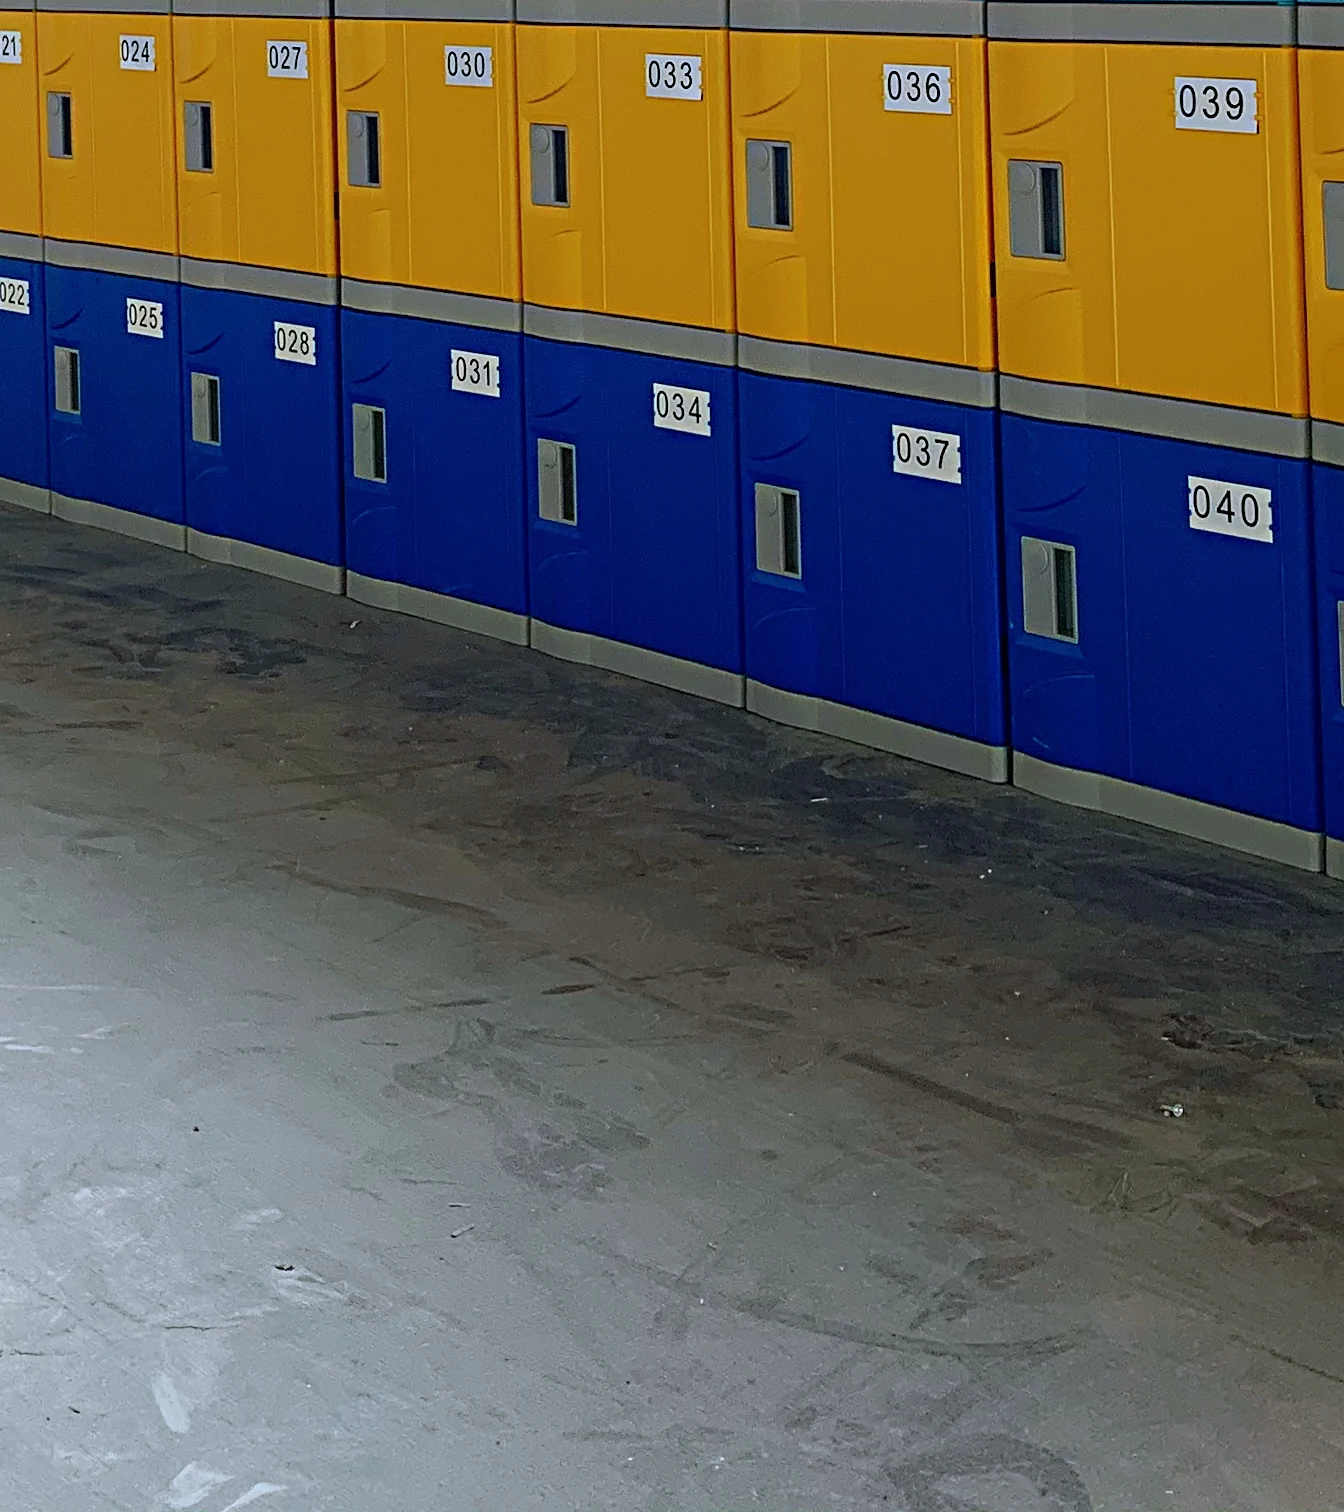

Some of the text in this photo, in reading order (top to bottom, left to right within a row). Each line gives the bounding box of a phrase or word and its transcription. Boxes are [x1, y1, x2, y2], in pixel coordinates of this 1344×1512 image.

[122, 40, 149, 62] 024
[270, 46, 300, 69] 027
[448, 51, 485, 77] 030
[649, 61, 692, 89] 033
[888, 71, 940, 102] 036
[1180, 85, 1243, 120] 039
[0, 282, 24, 305] 022
[129, 304, 157, 329] 025
[277, 328, 309, 355] 028
[456, 357, 490, 386] 031
[657, 391, 701, 423] 034
[897, 433, 949, 469] 037
[1194, 485, 1258, 527] 040
